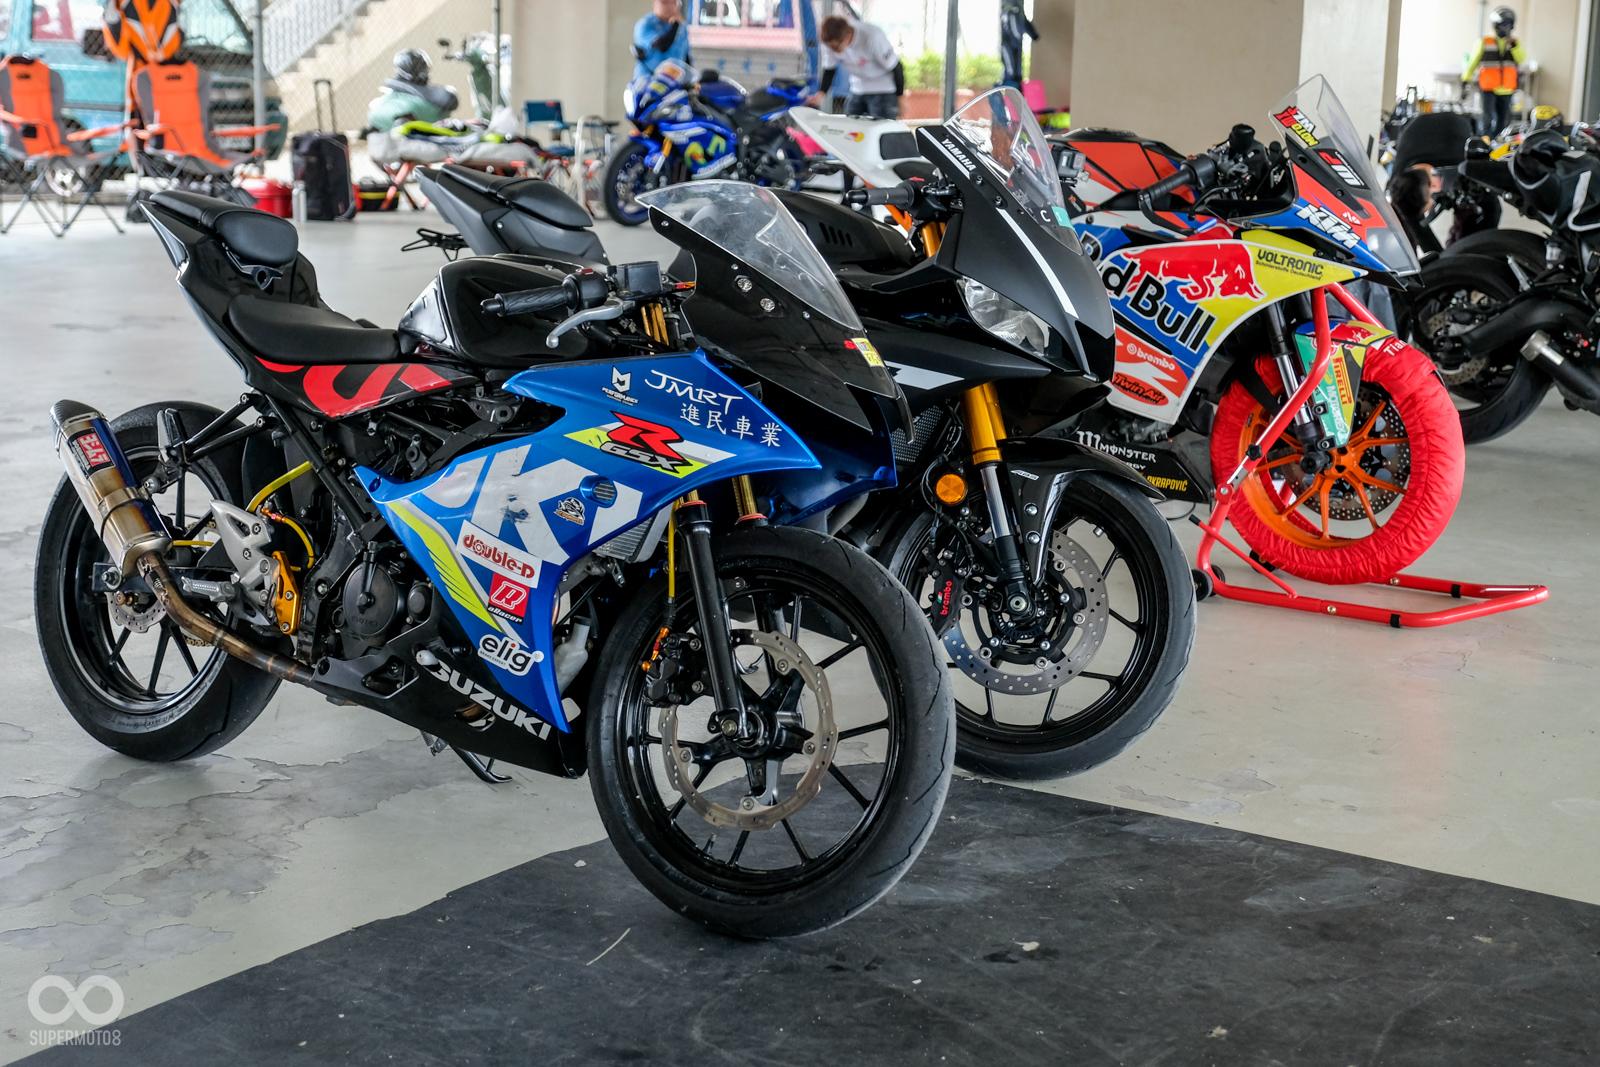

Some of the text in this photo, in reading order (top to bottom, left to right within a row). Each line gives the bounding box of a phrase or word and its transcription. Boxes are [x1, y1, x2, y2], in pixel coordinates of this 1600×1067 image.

[941, 138, 977, 172] YAMAHA
[1294, 203, 1362, 250] KTM
[1257, 248, 1324, 276] VOLTRONIC
[1128, 271, 1217, 353] Bull
[1136, 347, 1176, 371] brembo
[644, 369, 744, 415] JMRT
[1332, 356, 1353, 405] PIRELLI
[680, 402, 783, 448] 進民車業
[601, 441, 694, 474] GSX
[462, 533, 535, 579] double-D
[487, 605, 524, 624] aRacer
[940, 580, 953, 616] brembo
[481, 637, 532, 672] elig
[423, 658, 552, 741] SUZUKI
